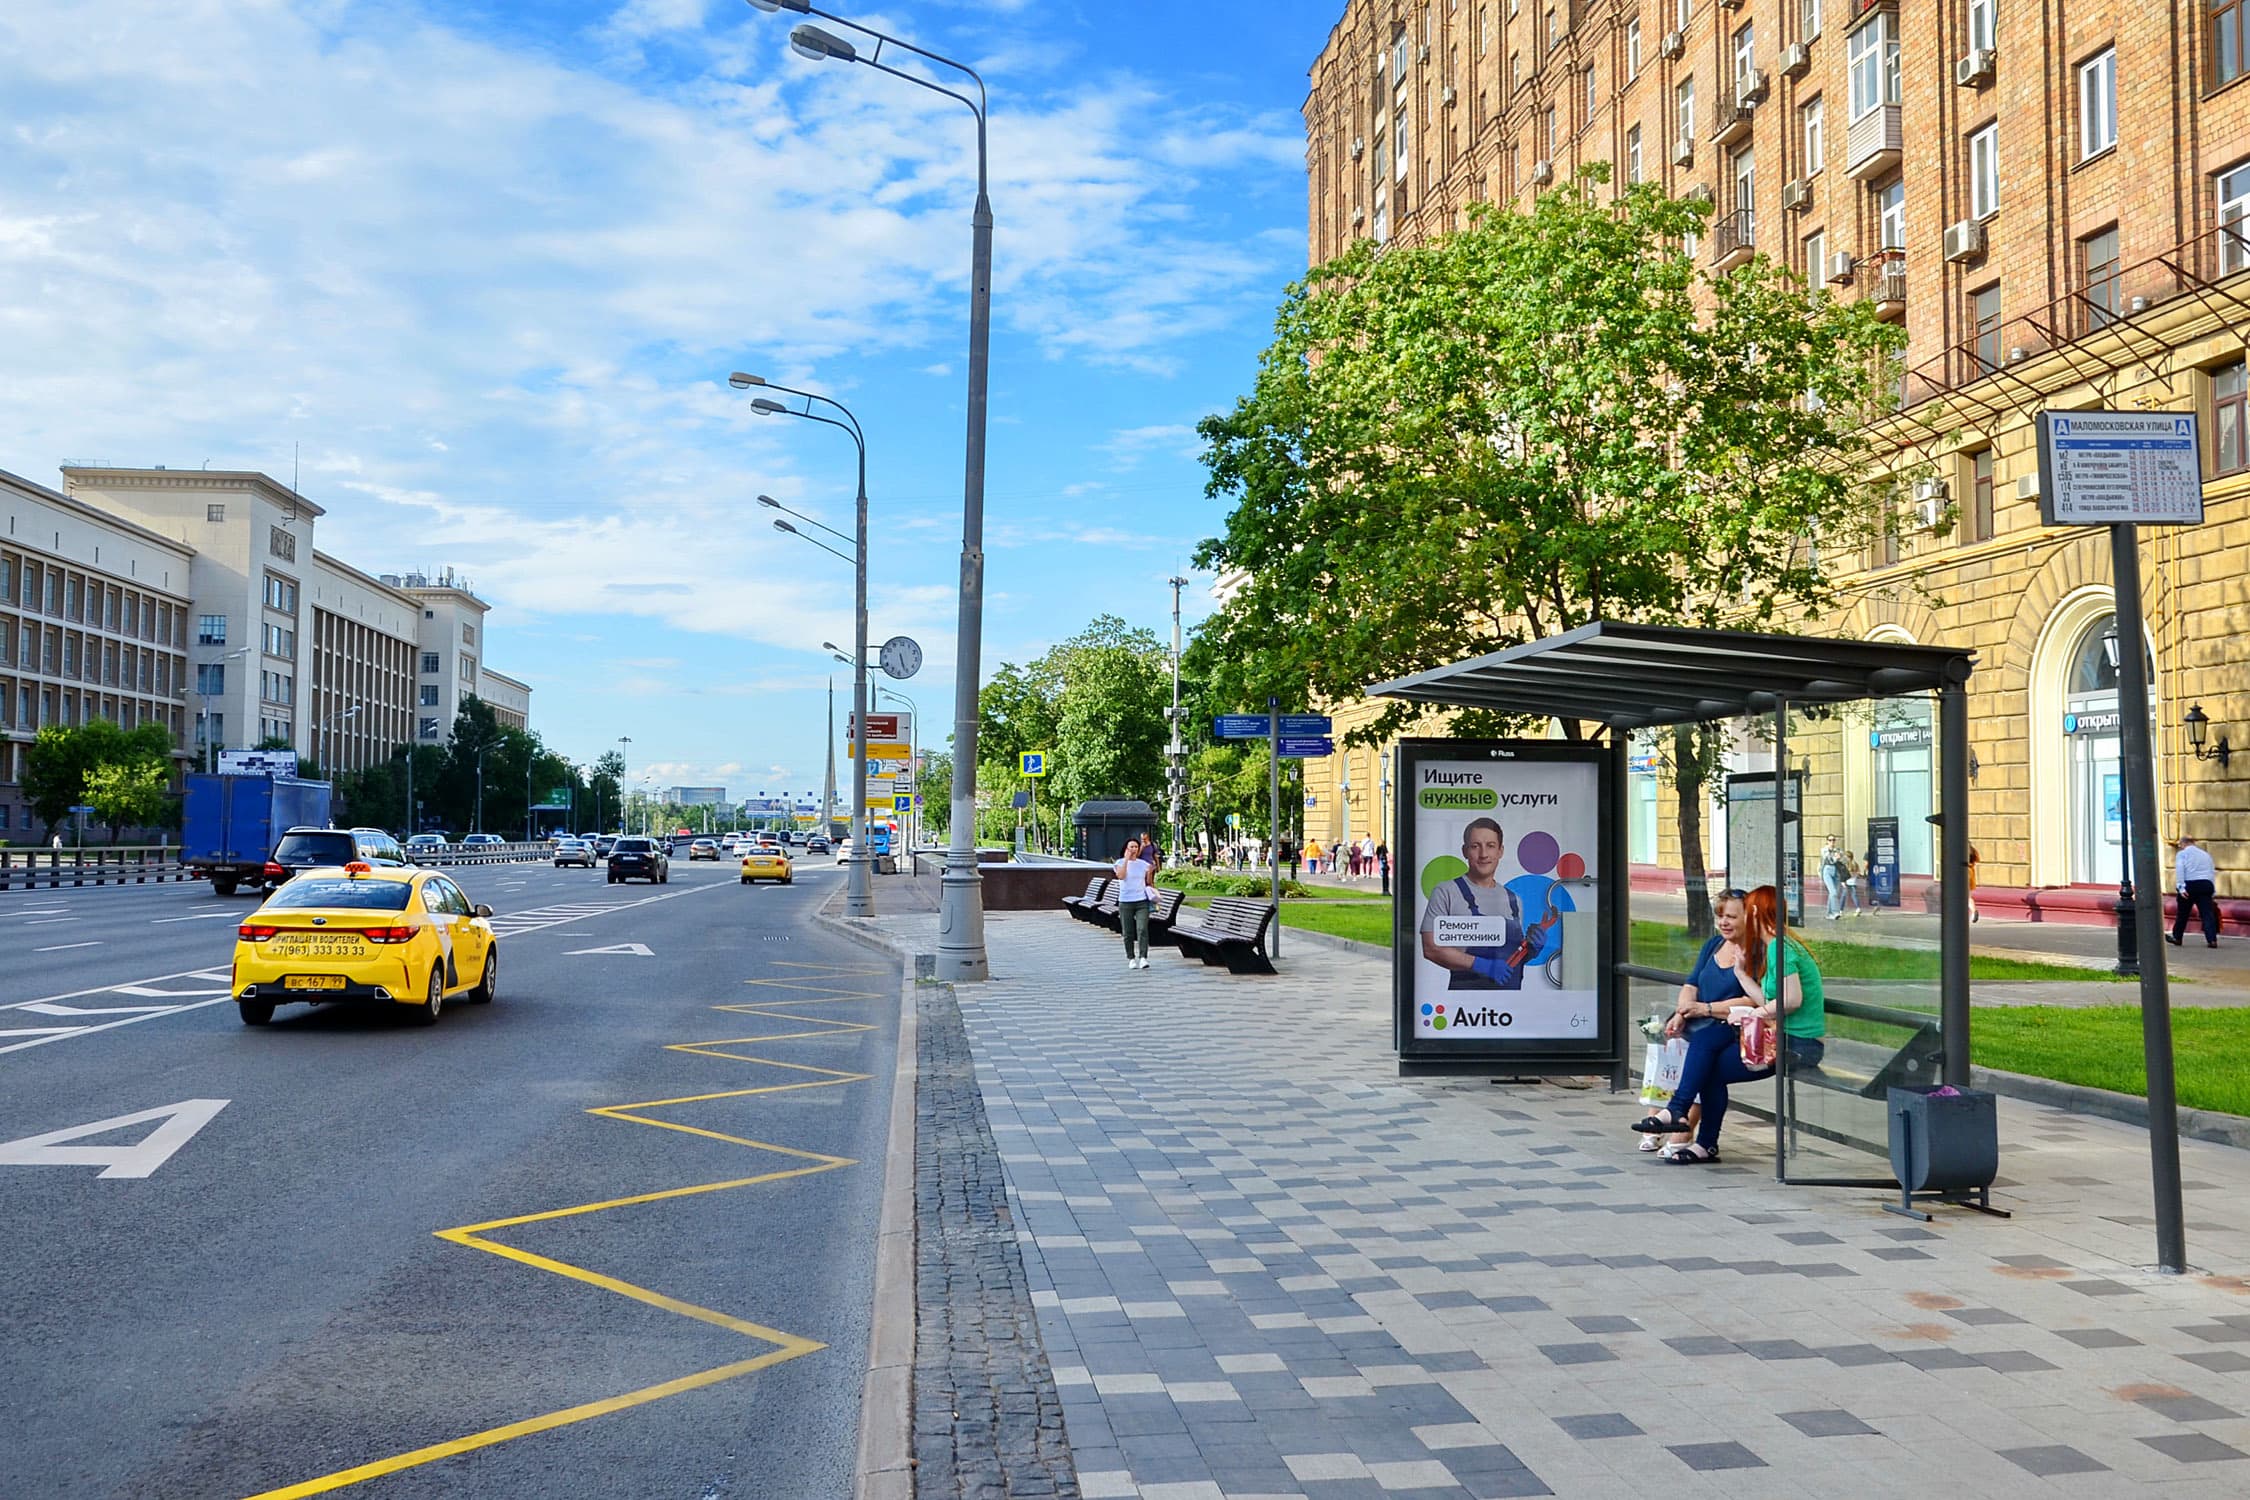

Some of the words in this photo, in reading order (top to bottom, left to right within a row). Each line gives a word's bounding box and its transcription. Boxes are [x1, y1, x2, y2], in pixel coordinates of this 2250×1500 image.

[2071, 421, 2145, 432] МАЛОМОСКОВСКАЯ
[2146, 422, 2173, 433] УЛИЦА
[2077, 713, 2120, 732] открыт
[1424, 768, 1483, 787] Ищите
[1424, 793, 1493, 807] нужные
[1500, 793, 1558, 809] услуги
[1439, 919, 1480, 931] Ремонт
[272, 936, 318, 944] ПРИГЛАШАЕМ
[320, 935, 360, 945] ВОДИТЕЛЕЙ
[1439, 933, 1501, 942] сантехники
[313, 945, 333, 956] 333
[336, 945, 349, 956] 33
[352, 946, 366, 957] 33
[307, 978, 326, 988] 167
[1453, 1007, 1513, 1027] Avito
[1570, 1014, 1589, 1028] 6+
